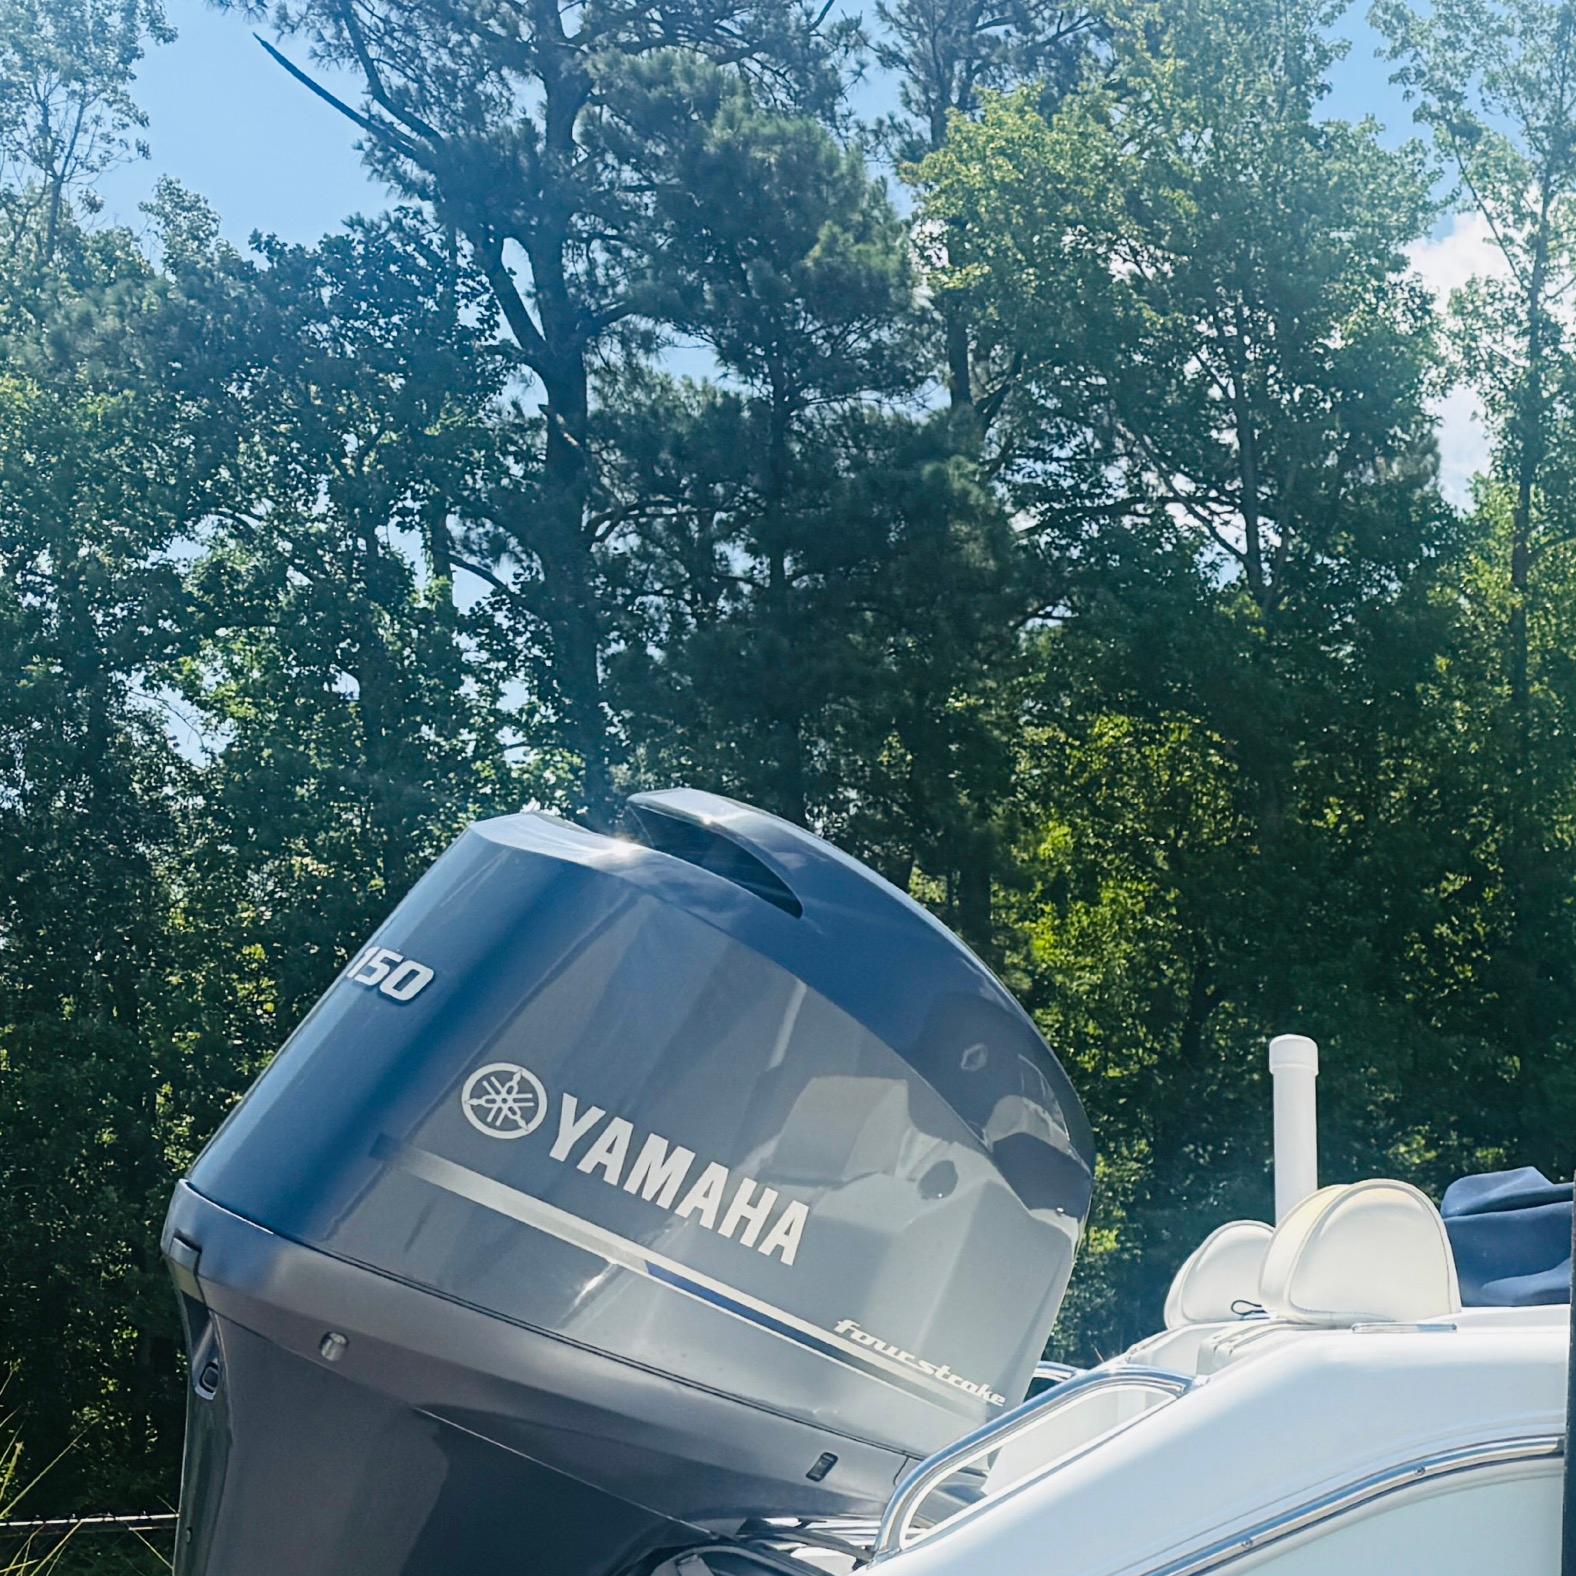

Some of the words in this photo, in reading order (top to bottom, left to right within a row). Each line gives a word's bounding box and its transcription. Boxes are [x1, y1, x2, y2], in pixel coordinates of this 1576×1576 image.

[347, 945, 434, 1001] 150
[549, 1091, 811, 1266] YAMAHA
[834, 1319, 1006, 1407] fourstroke
